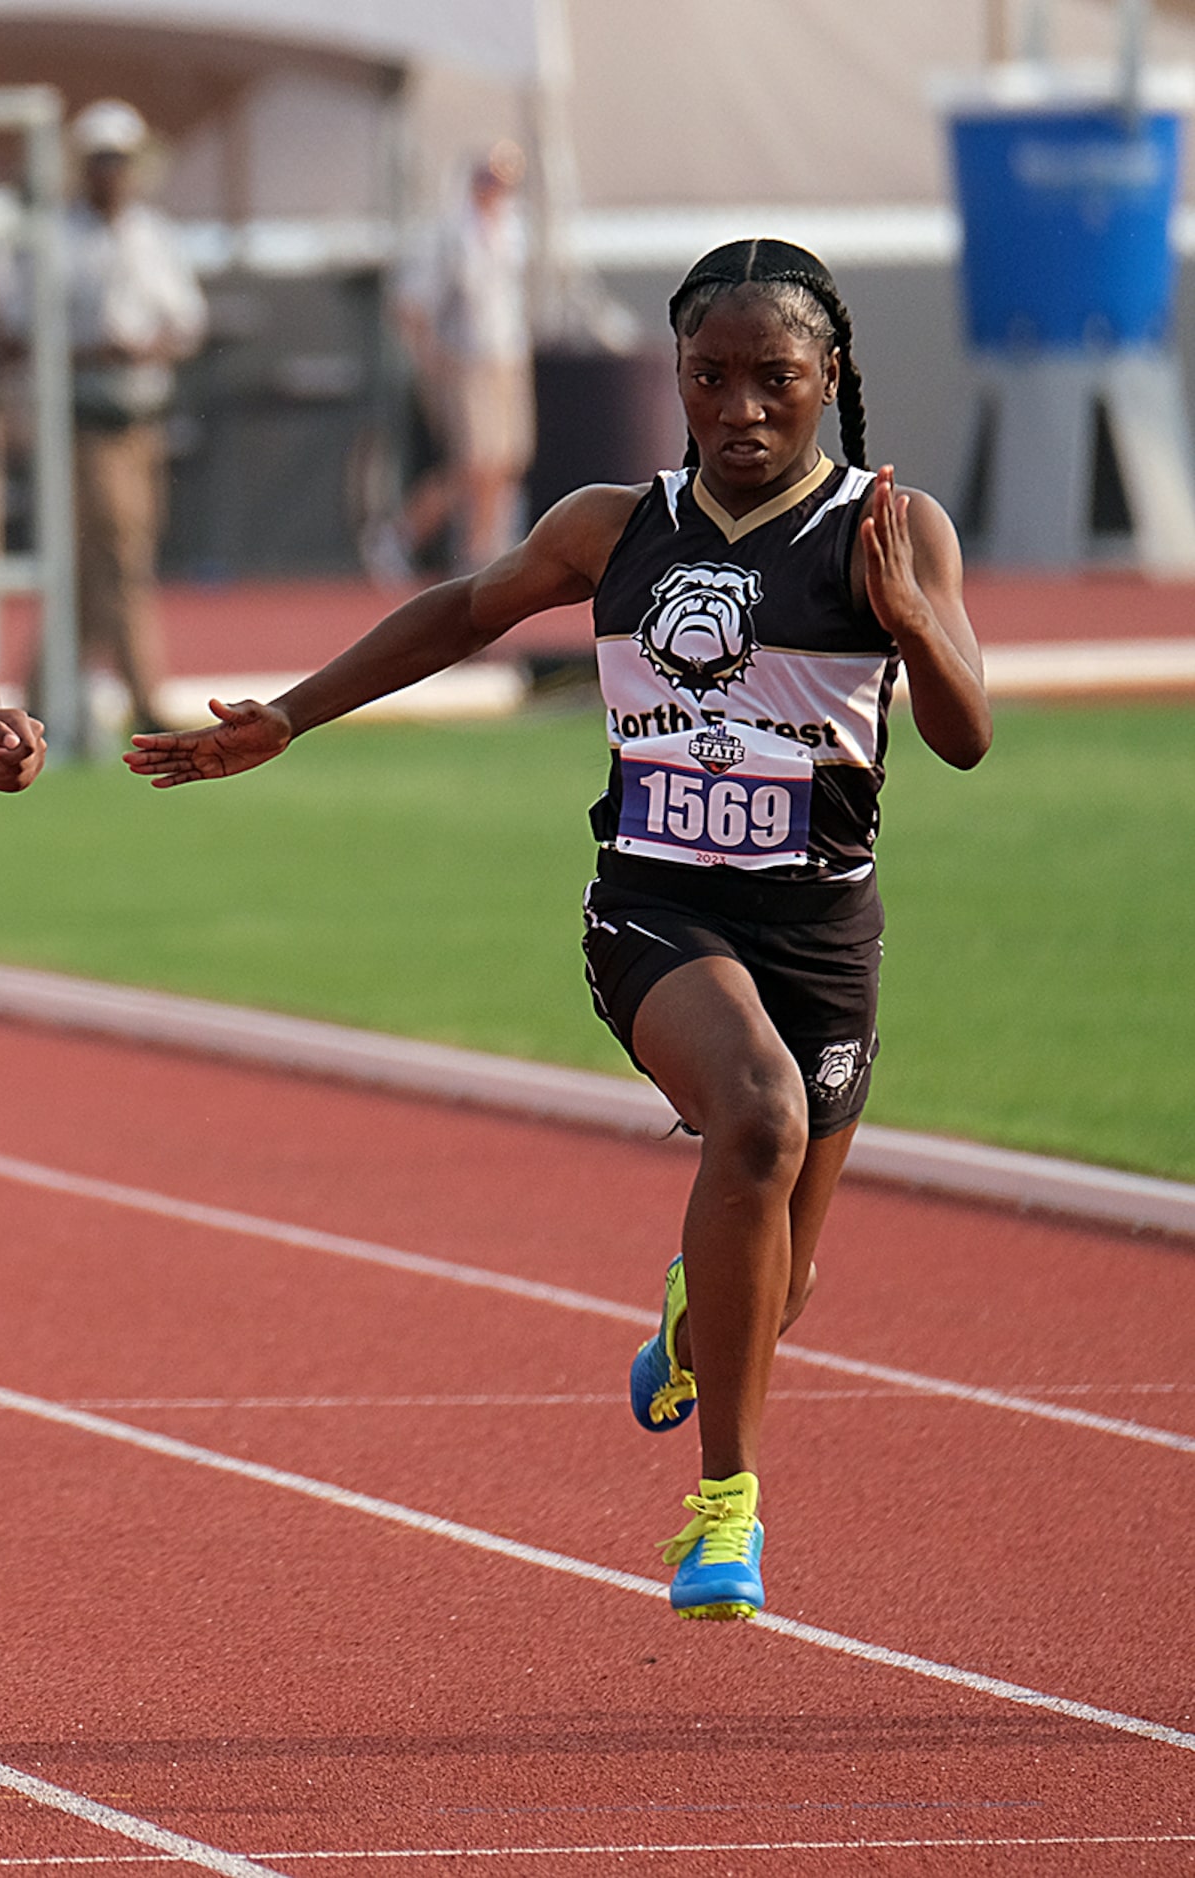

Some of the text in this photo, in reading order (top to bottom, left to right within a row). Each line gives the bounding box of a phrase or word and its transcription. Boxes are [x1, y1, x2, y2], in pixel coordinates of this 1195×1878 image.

[700, 708, 839, 749] Frest
[689, 741, 743, 760] STATE
[639, 770, 792, 849] 1569
[696, 852, 726, 865] 2023
